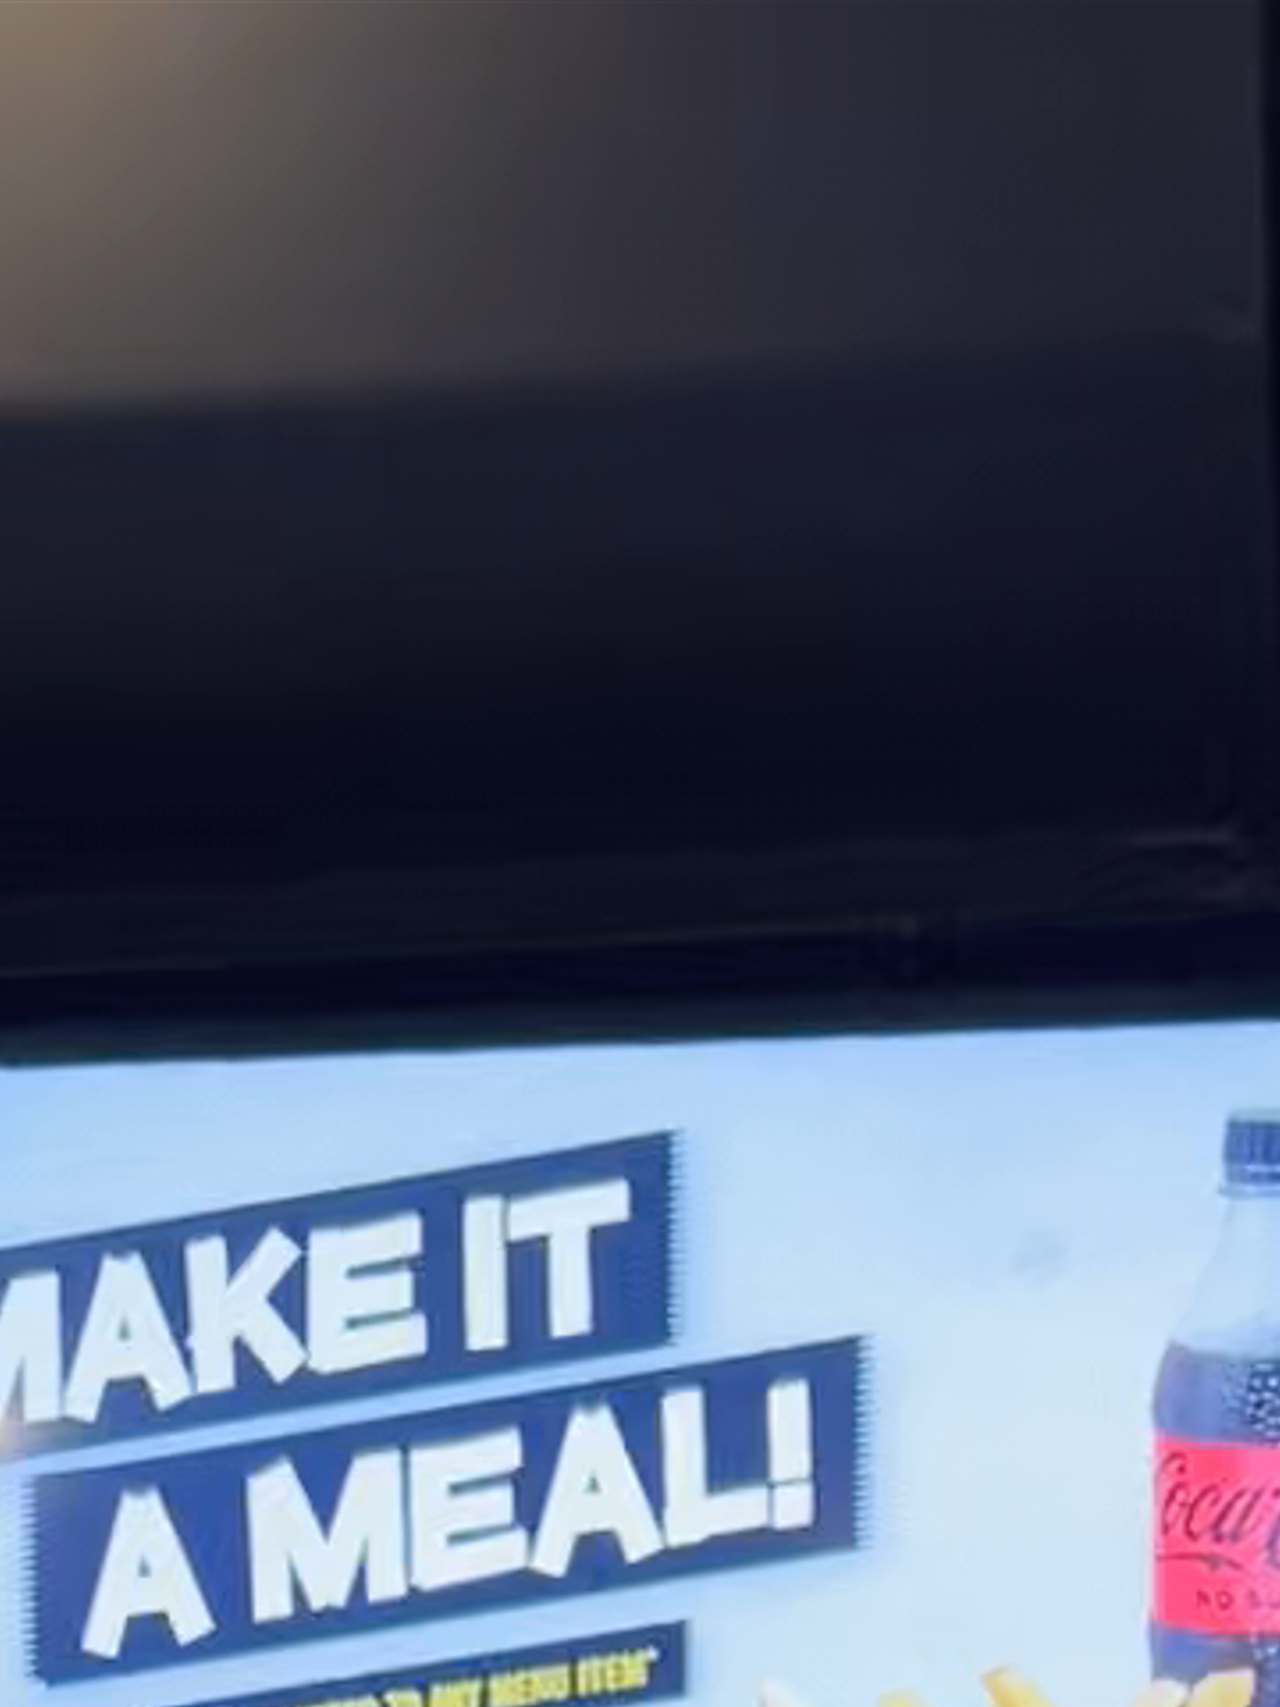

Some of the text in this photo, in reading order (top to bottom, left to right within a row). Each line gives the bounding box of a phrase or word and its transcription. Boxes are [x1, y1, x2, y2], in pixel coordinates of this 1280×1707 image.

[462, 1178, 631, 1353] IT
[80, 1379, 815, 1659] A MEAL!
